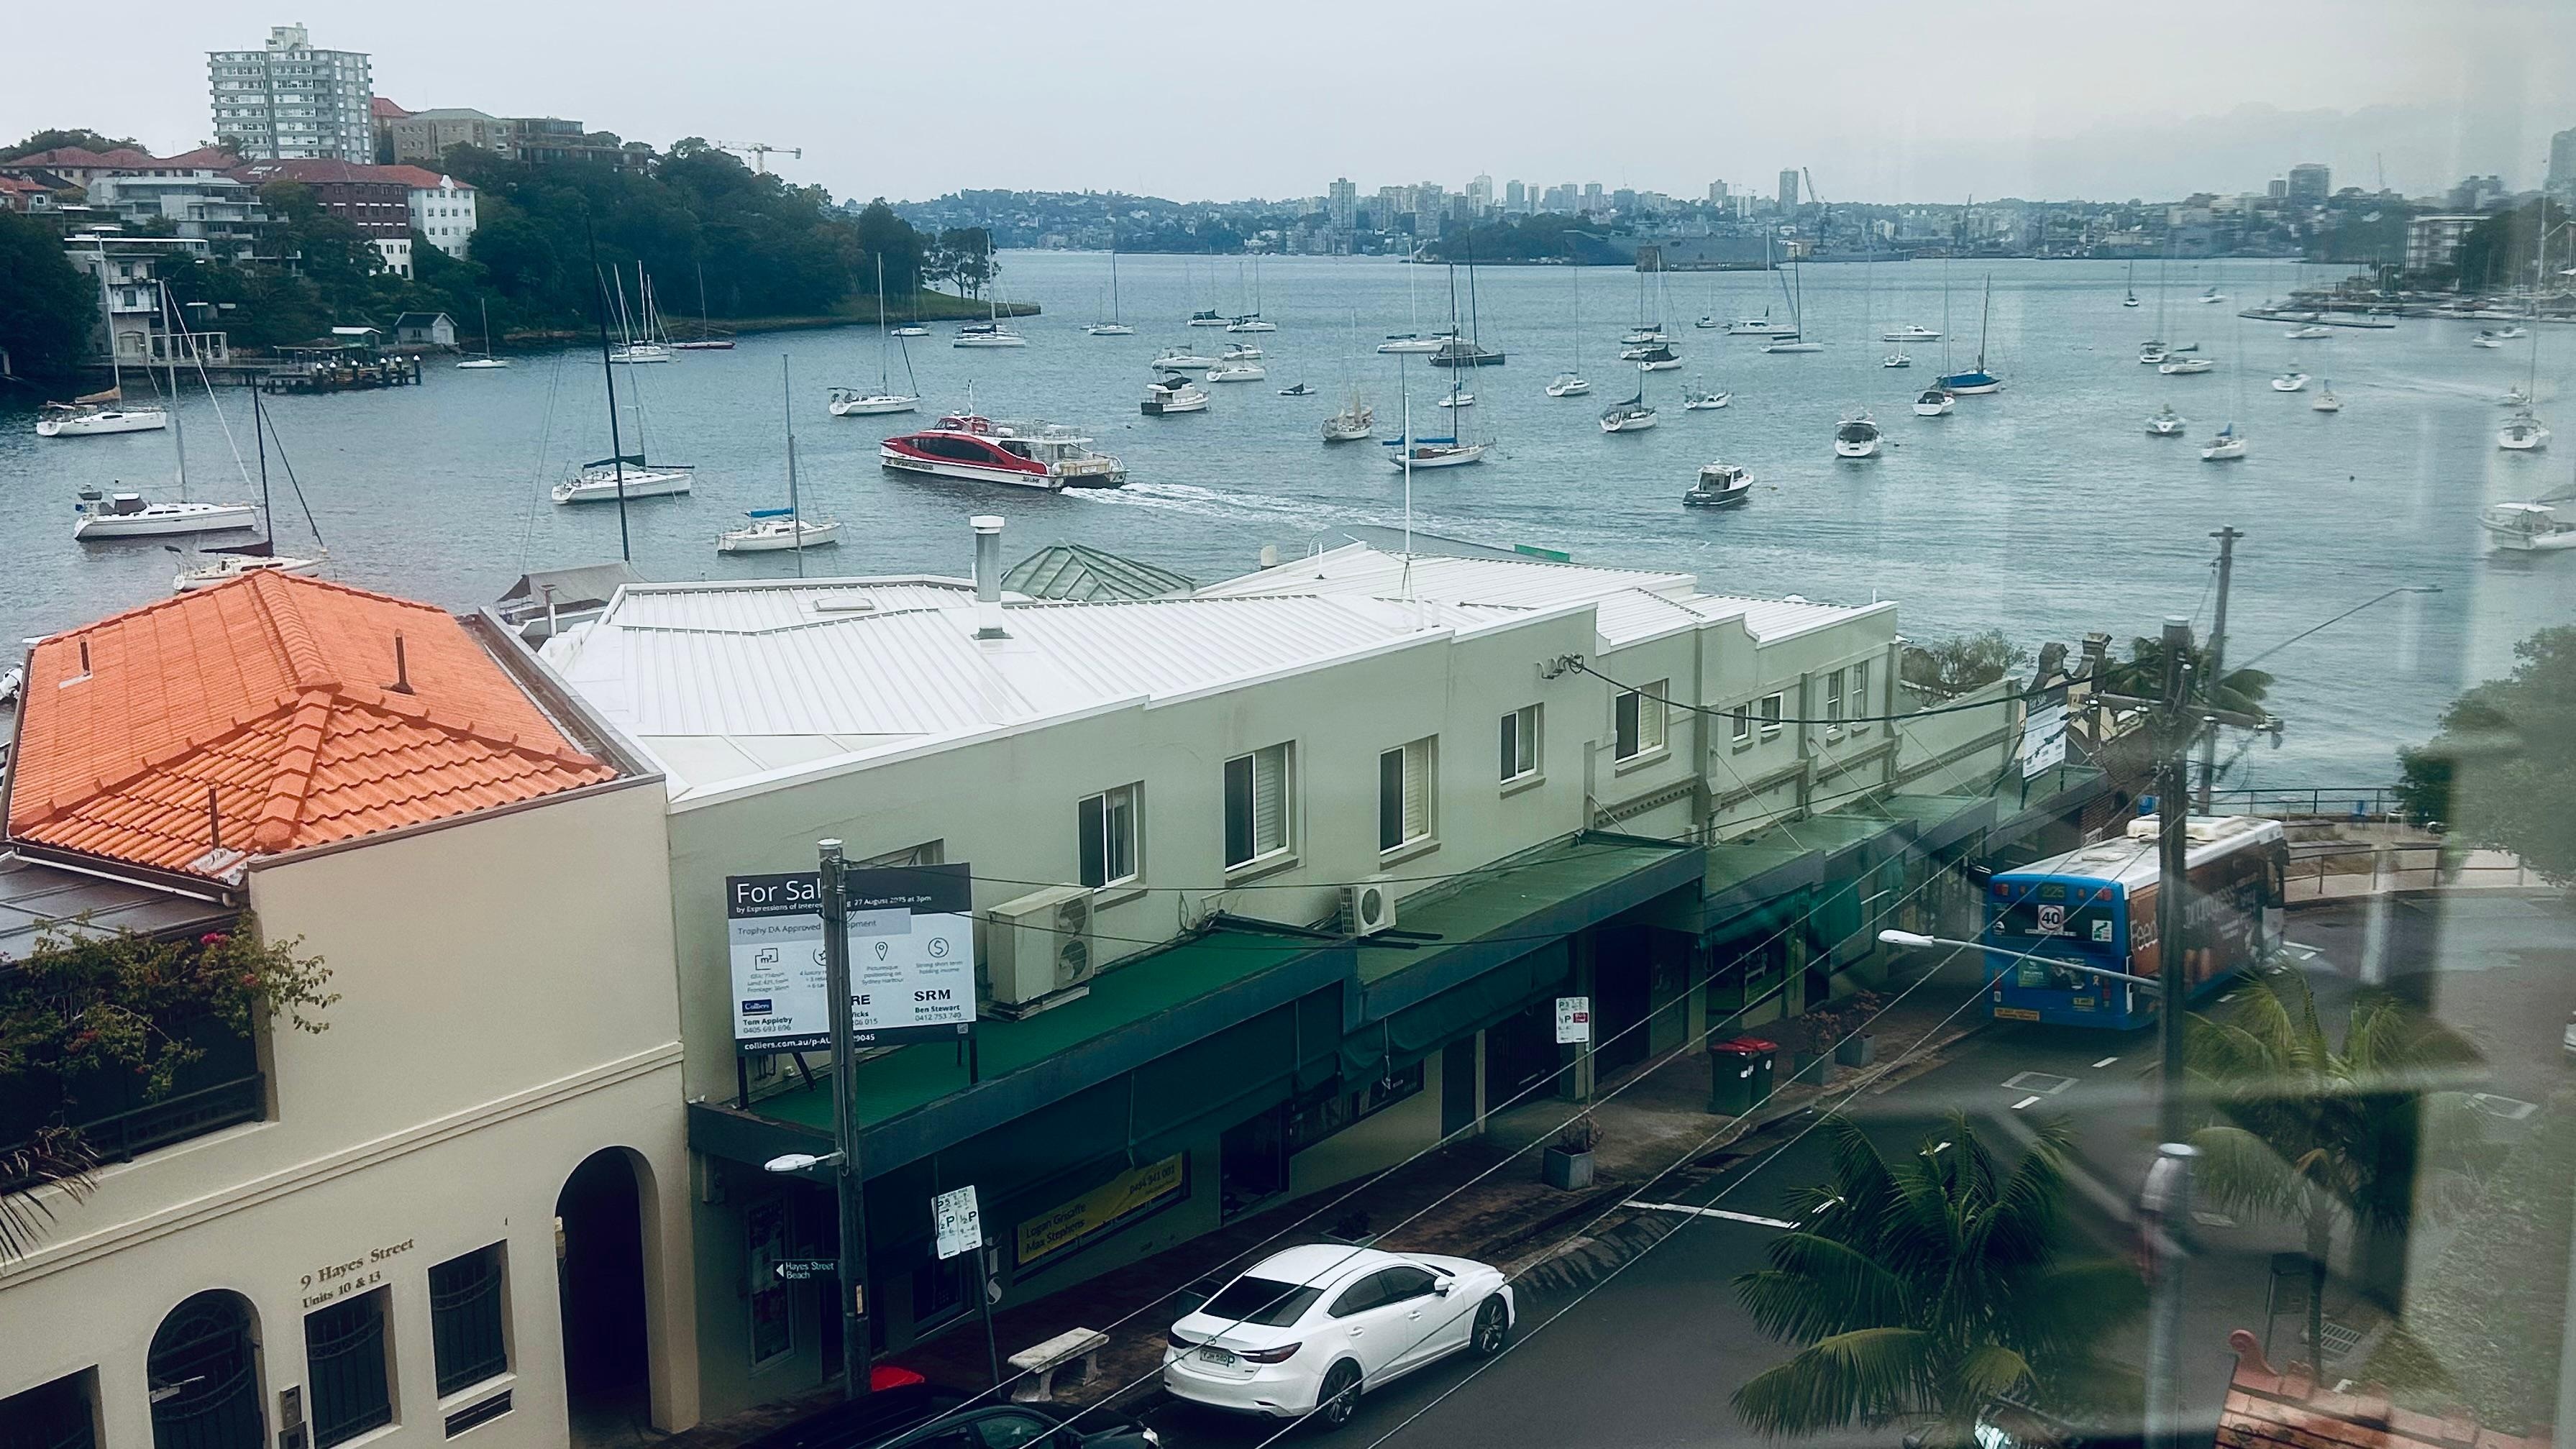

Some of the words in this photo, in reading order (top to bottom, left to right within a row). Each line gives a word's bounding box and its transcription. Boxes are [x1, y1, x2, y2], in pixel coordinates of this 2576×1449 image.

[736, 883, 777, 903] For
[785, 878, 821, 901] Sal
[2042, 885, 2065, 898] 225
[746, 904, 787, 913] Expressions
[2042, 912, 2060, 925] 40
[738, 926, 766, 936] Trophy
[782, 923, 821, 933] Approved
[847, 920, 877, 929] opment
[851, 995, 871, 1005] RE
[914, 989, 951, 1002] SRM
[762, 1016, 793, 1027] Appleby
[1565, 1015, 1571, 1023] P
[946, 1216, 955, 1228] P
[968, 1211, 977, 1222] P
[1026, 1217, 1052, 1239] Logan
[1046, 1218, 1086, 1245] Stephens
[301, 1275, 311, 1292] 9
[318, 1258, 363, 1282] Hayes
[370, 1238, 414, 1263] Street
[785, 1261, 809, 1271] Hayes
[810, 1261, 834, 1271] Street
[786, 1271, 810, 1279] Beach
[303, 1289, 334, 1309] Units
[338, 1281, 352, 1296] 10
[355, 1277, 365, 1289] &
[369, 1271, 381, 1283] 13
